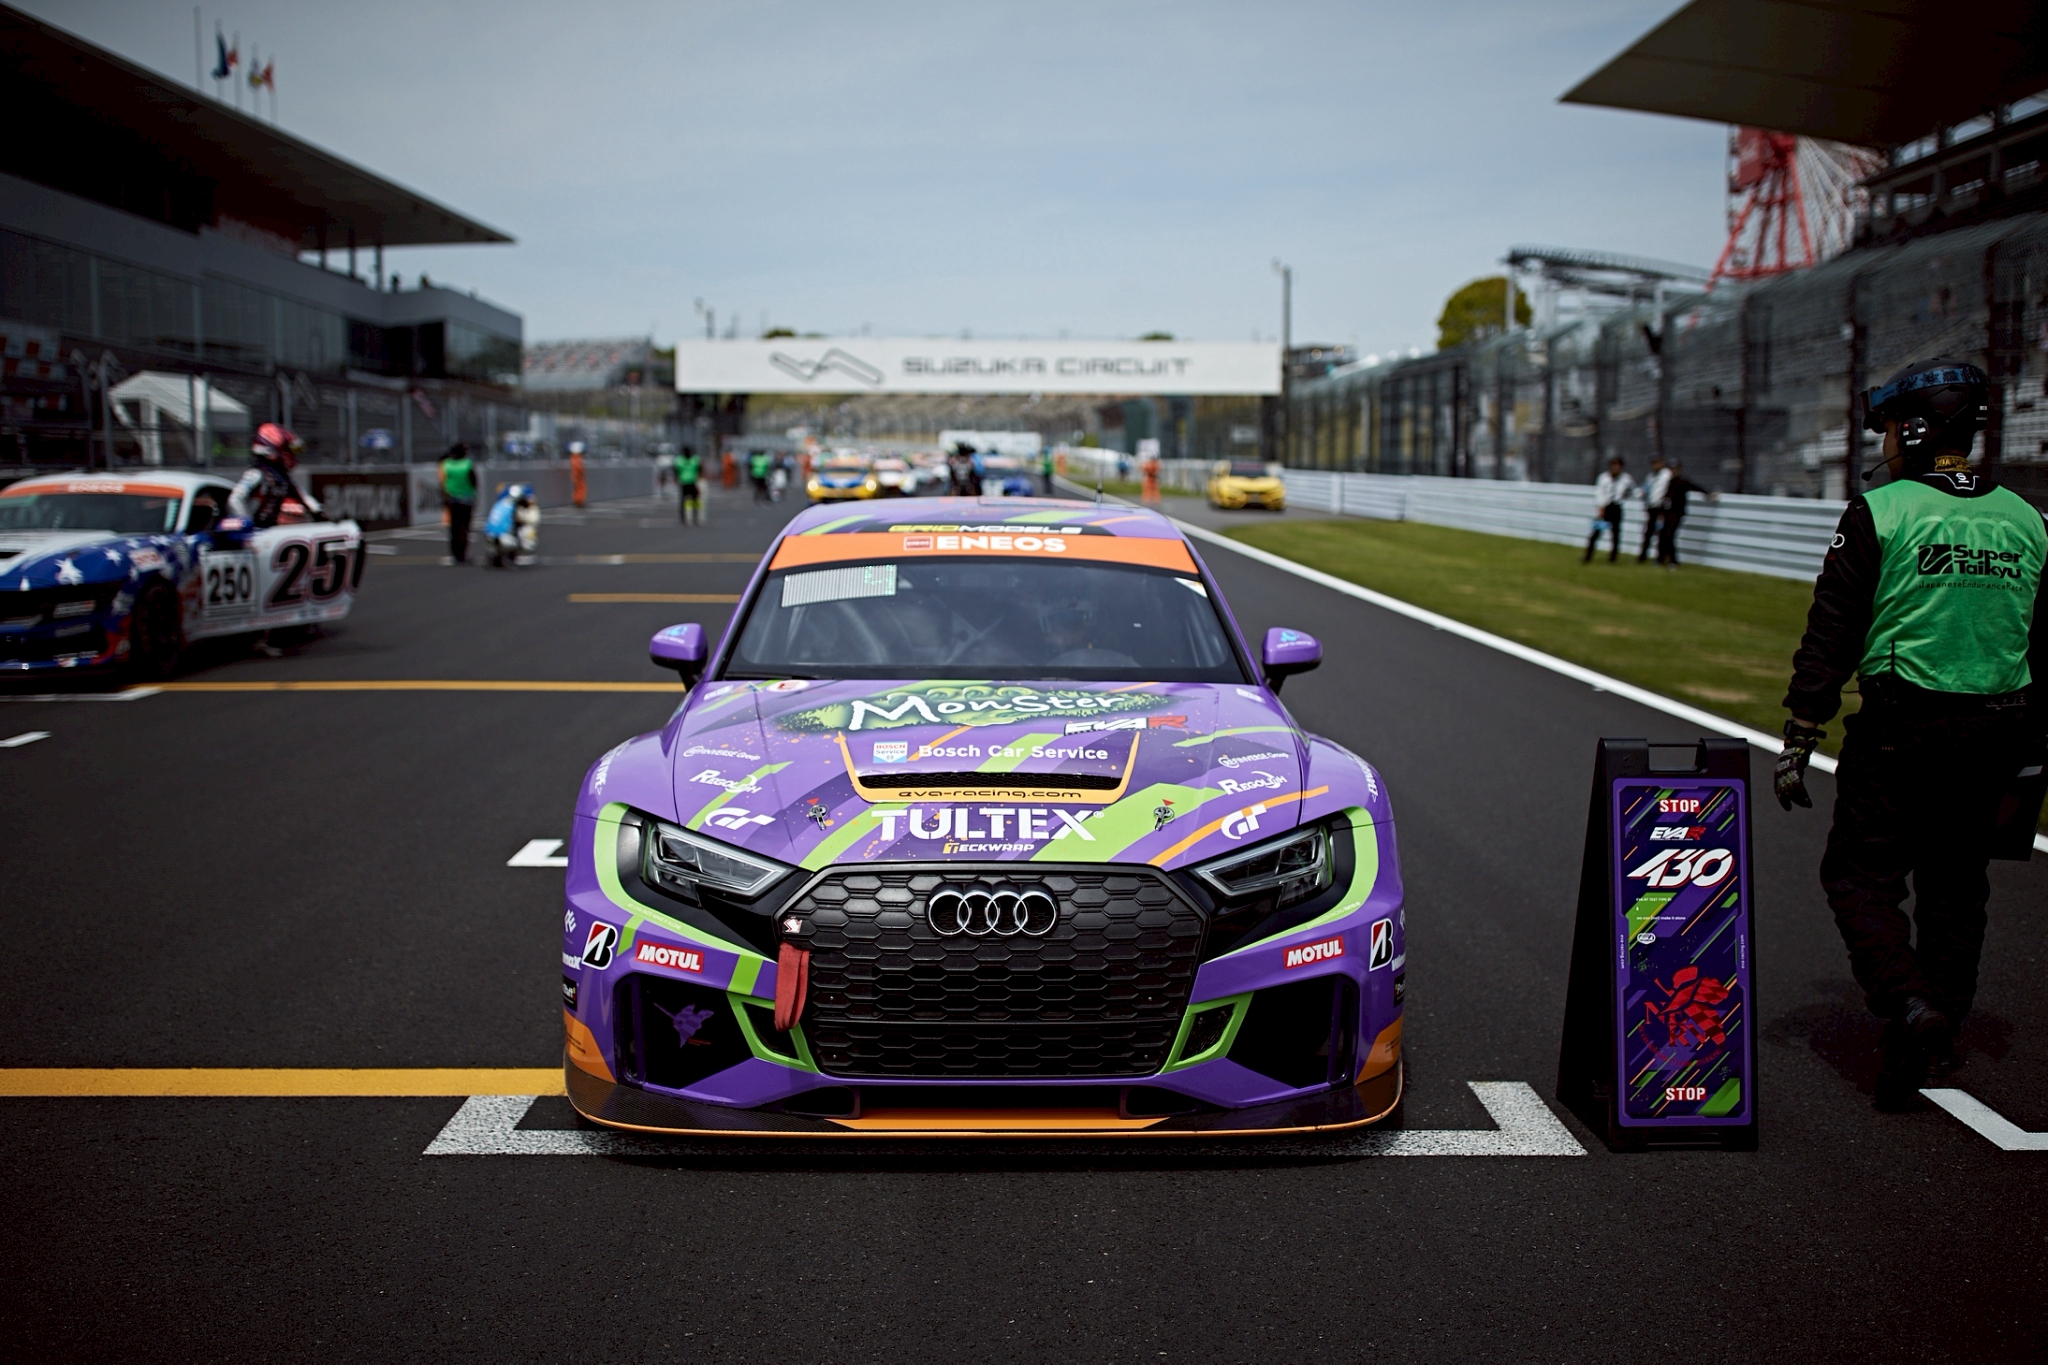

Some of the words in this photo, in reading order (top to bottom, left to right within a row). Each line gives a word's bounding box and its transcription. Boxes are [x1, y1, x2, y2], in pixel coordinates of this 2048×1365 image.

[902, 356, 1046, 377] SUZUKA
[1054, 356, 1192, 377] CIRCUIT
[936, 536, 1067, 553] ENEOS
[1953, 544, 2022, 564] Super
[1953, 560, 2022, 579] Taikyu
[208, 566, 251, 603] 250
[918, 745, 981, 758] Bosch
[988, 745, 1024, 758] Car
[1031, 745, 1109, 760] Service
[898, 789, 1082, 799] eva-racing.com
[1659, 799, 1700, 813] STOP
[1627, 848, 1735, 887] 430
[637, 943, 701, 971] MOTUL
[1286, 940, 1342, 967] MOTUL
[1665, 1087, 1706, 1101] STOP
